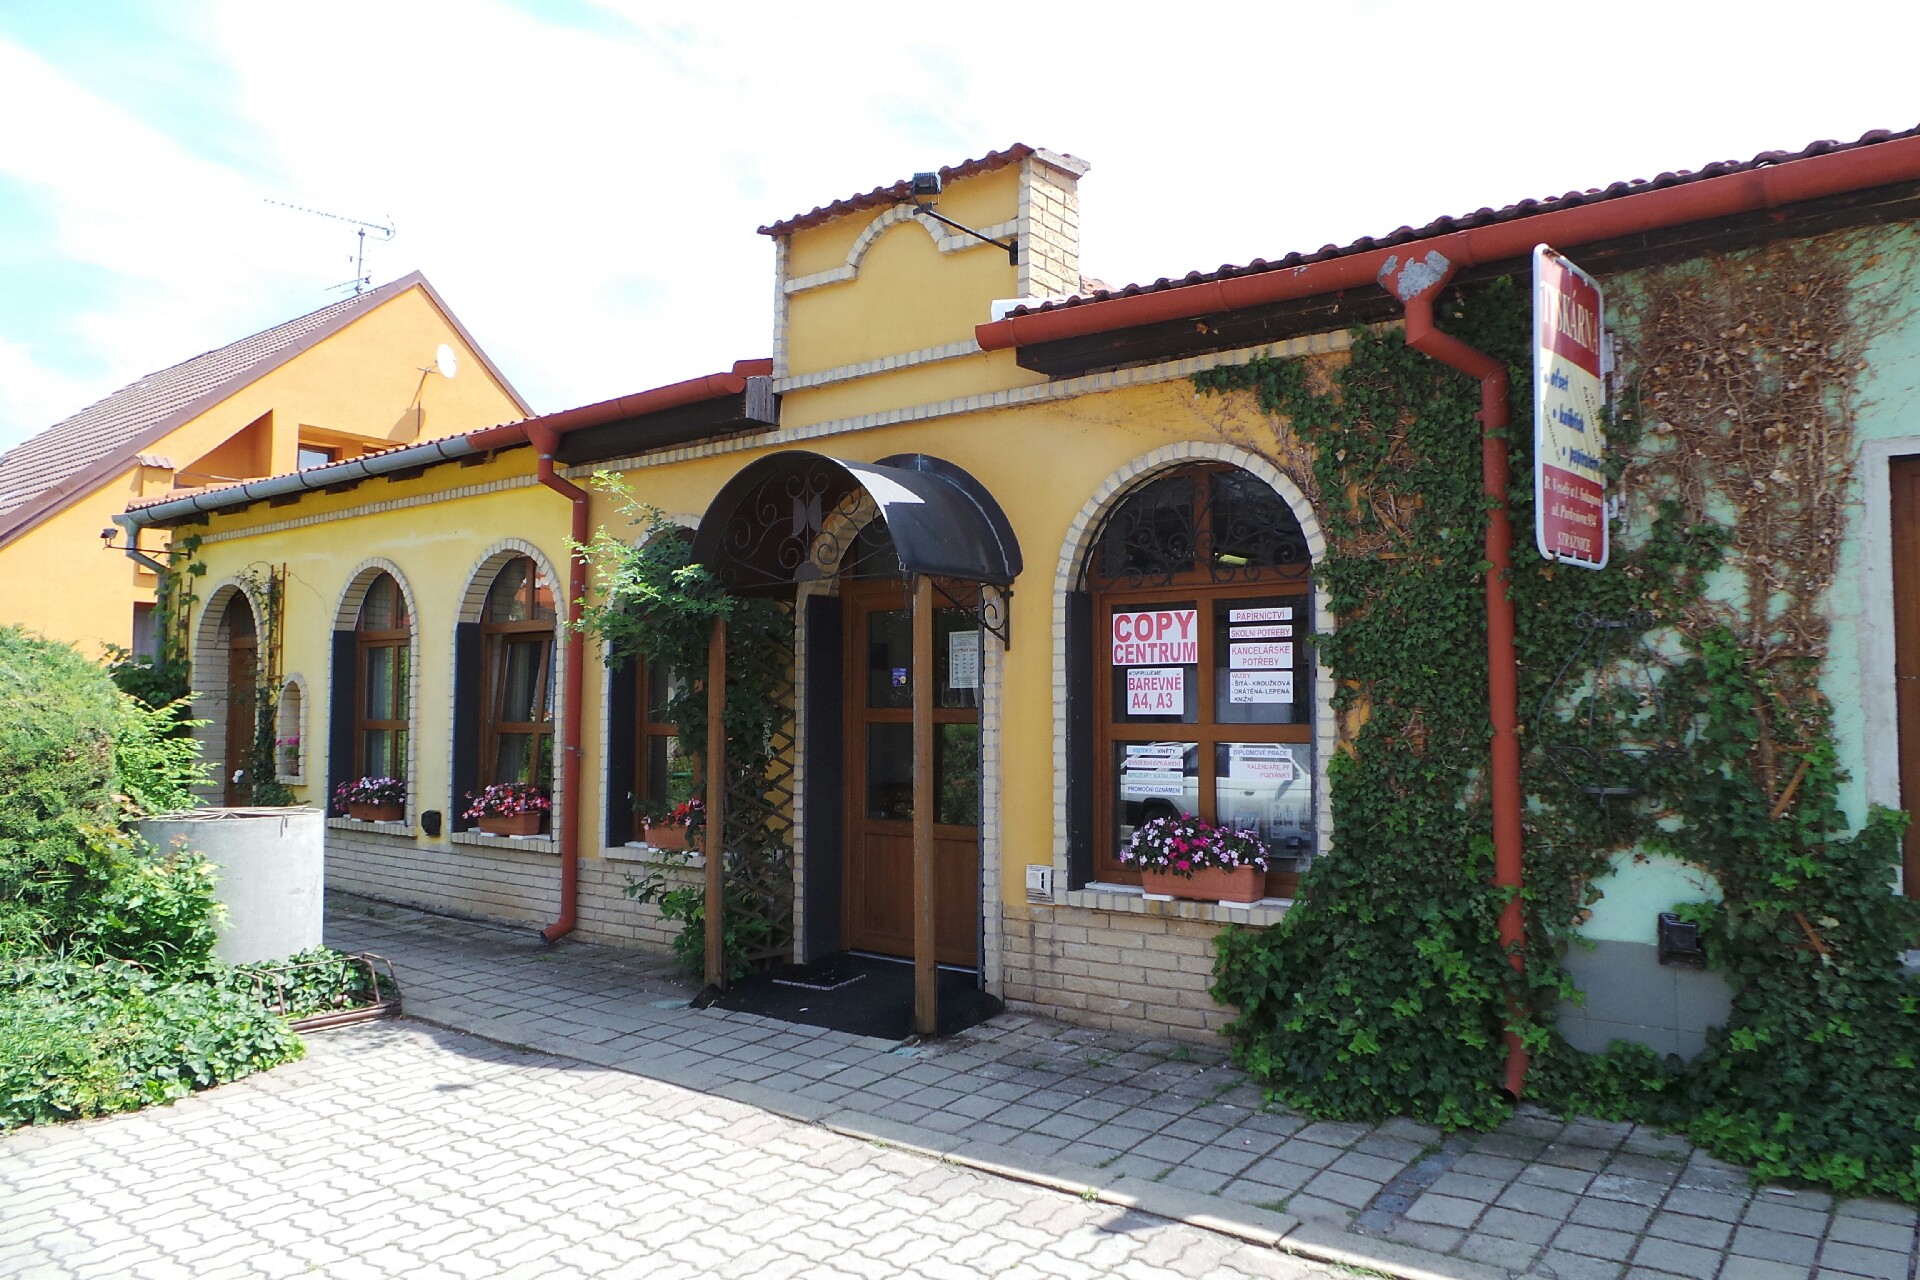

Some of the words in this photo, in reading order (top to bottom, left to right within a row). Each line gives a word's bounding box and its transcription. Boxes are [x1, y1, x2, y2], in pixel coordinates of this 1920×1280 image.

[1557, 530, 1591, 553] STRÁŽNICE
[1236, 609, 1285, 620] PAPÍRNICTVÍ
[1114, 611, 1195, 642] COPY
[1231, 629, 1256, 637] ŠKOLNÍ
[1257, 627, 1290, 637] POTŘEBY
[1113, 642, 1196, 663] CENTRUM
[1231, 644, 1290, 655] KANCELÁŘSKÉ
[1242, 656, 1279, 666] POTŘEBY
[1128, 673, 1181, 690] BAREVNĚ
[1132, 692, 1152, 711] A4,
[1156, 692, 1173, 708] A3
[1154, 786, 1180, 794] OZNÁMENÍ
